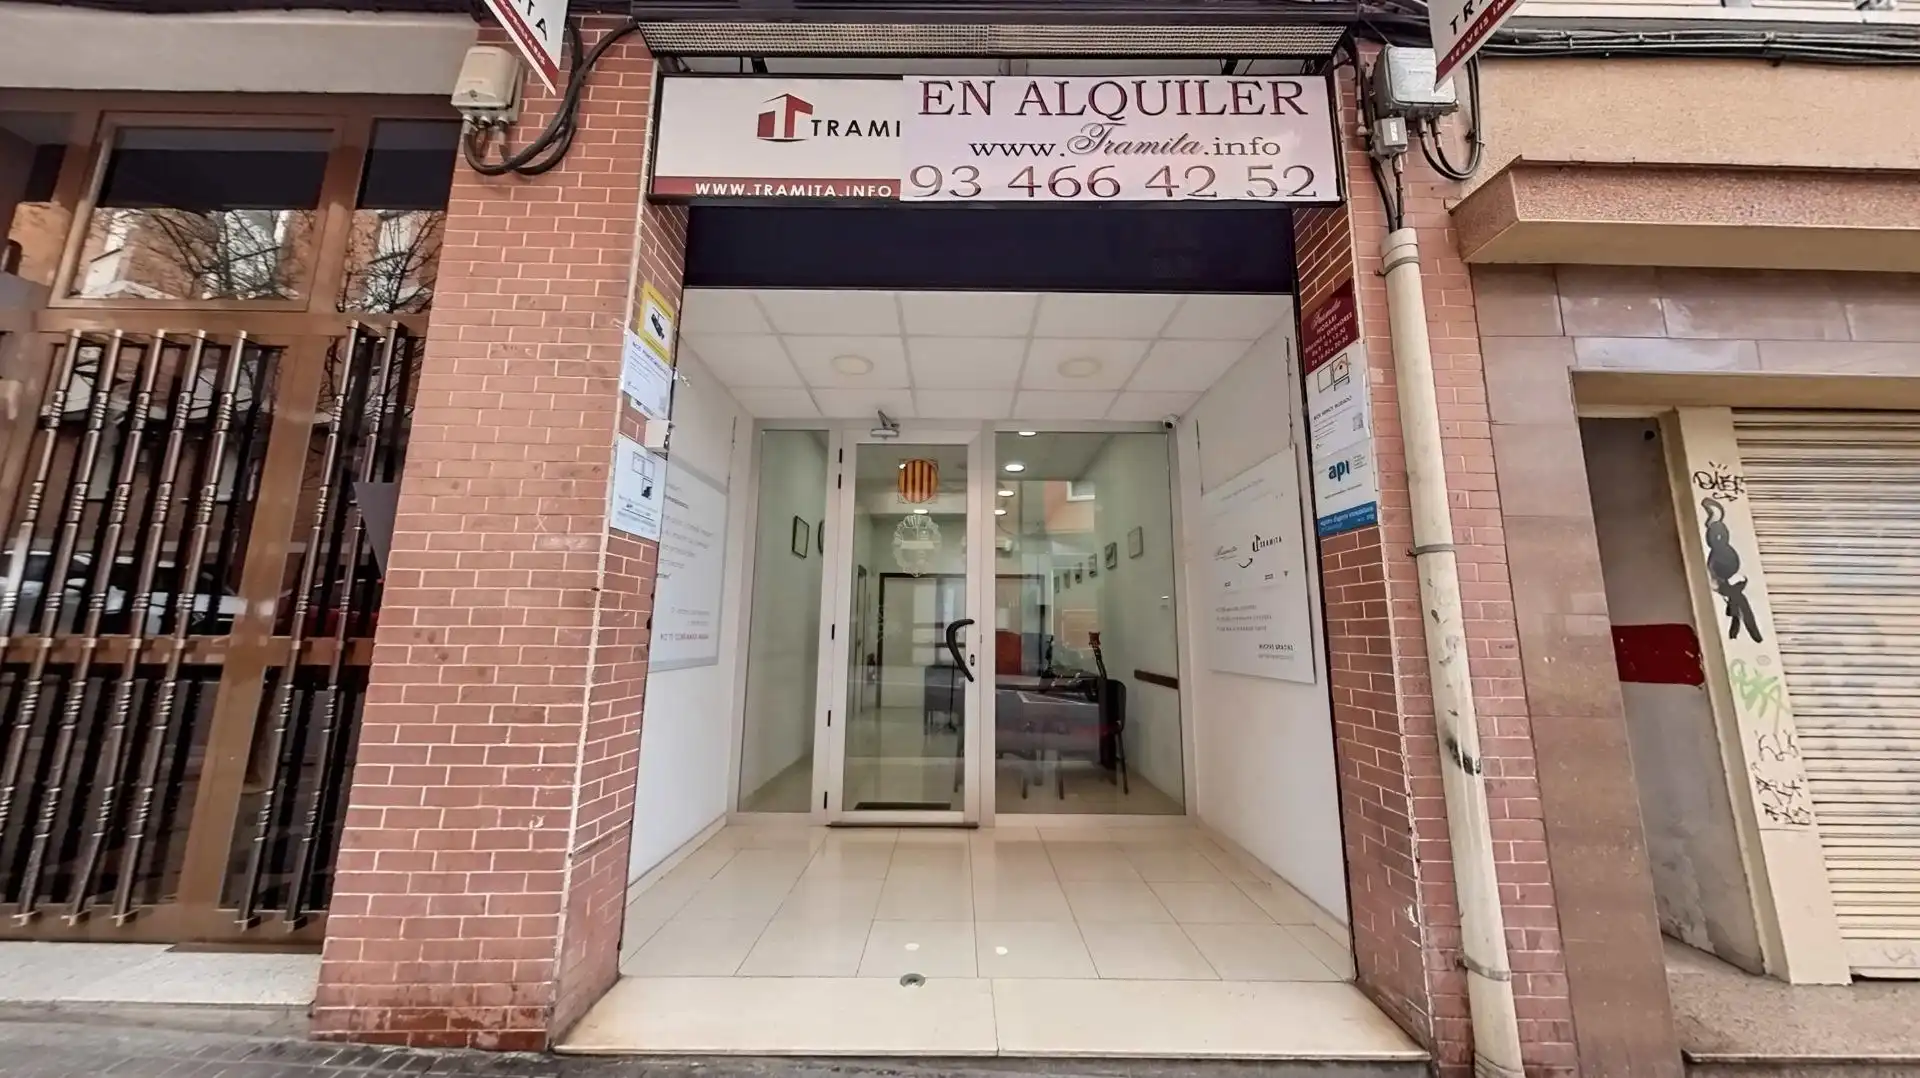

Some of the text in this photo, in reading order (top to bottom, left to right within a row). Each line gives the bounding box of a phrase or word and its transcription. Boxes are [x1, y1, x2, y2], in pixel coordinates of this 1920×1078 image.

[1448, 0, 1482, 35] TR
[918, 79, 1308, 121] EN ALQUILER
[811, 119, 901, 138] TRAMI
[969, 122, 1281, 157] www.Tramita.info
[694, 182, 893, 198] WWW.TRAMITA.INFO
[909, 164, 1316, 198] 93 466 42 52
[1328, 459, 1351, 482] api
